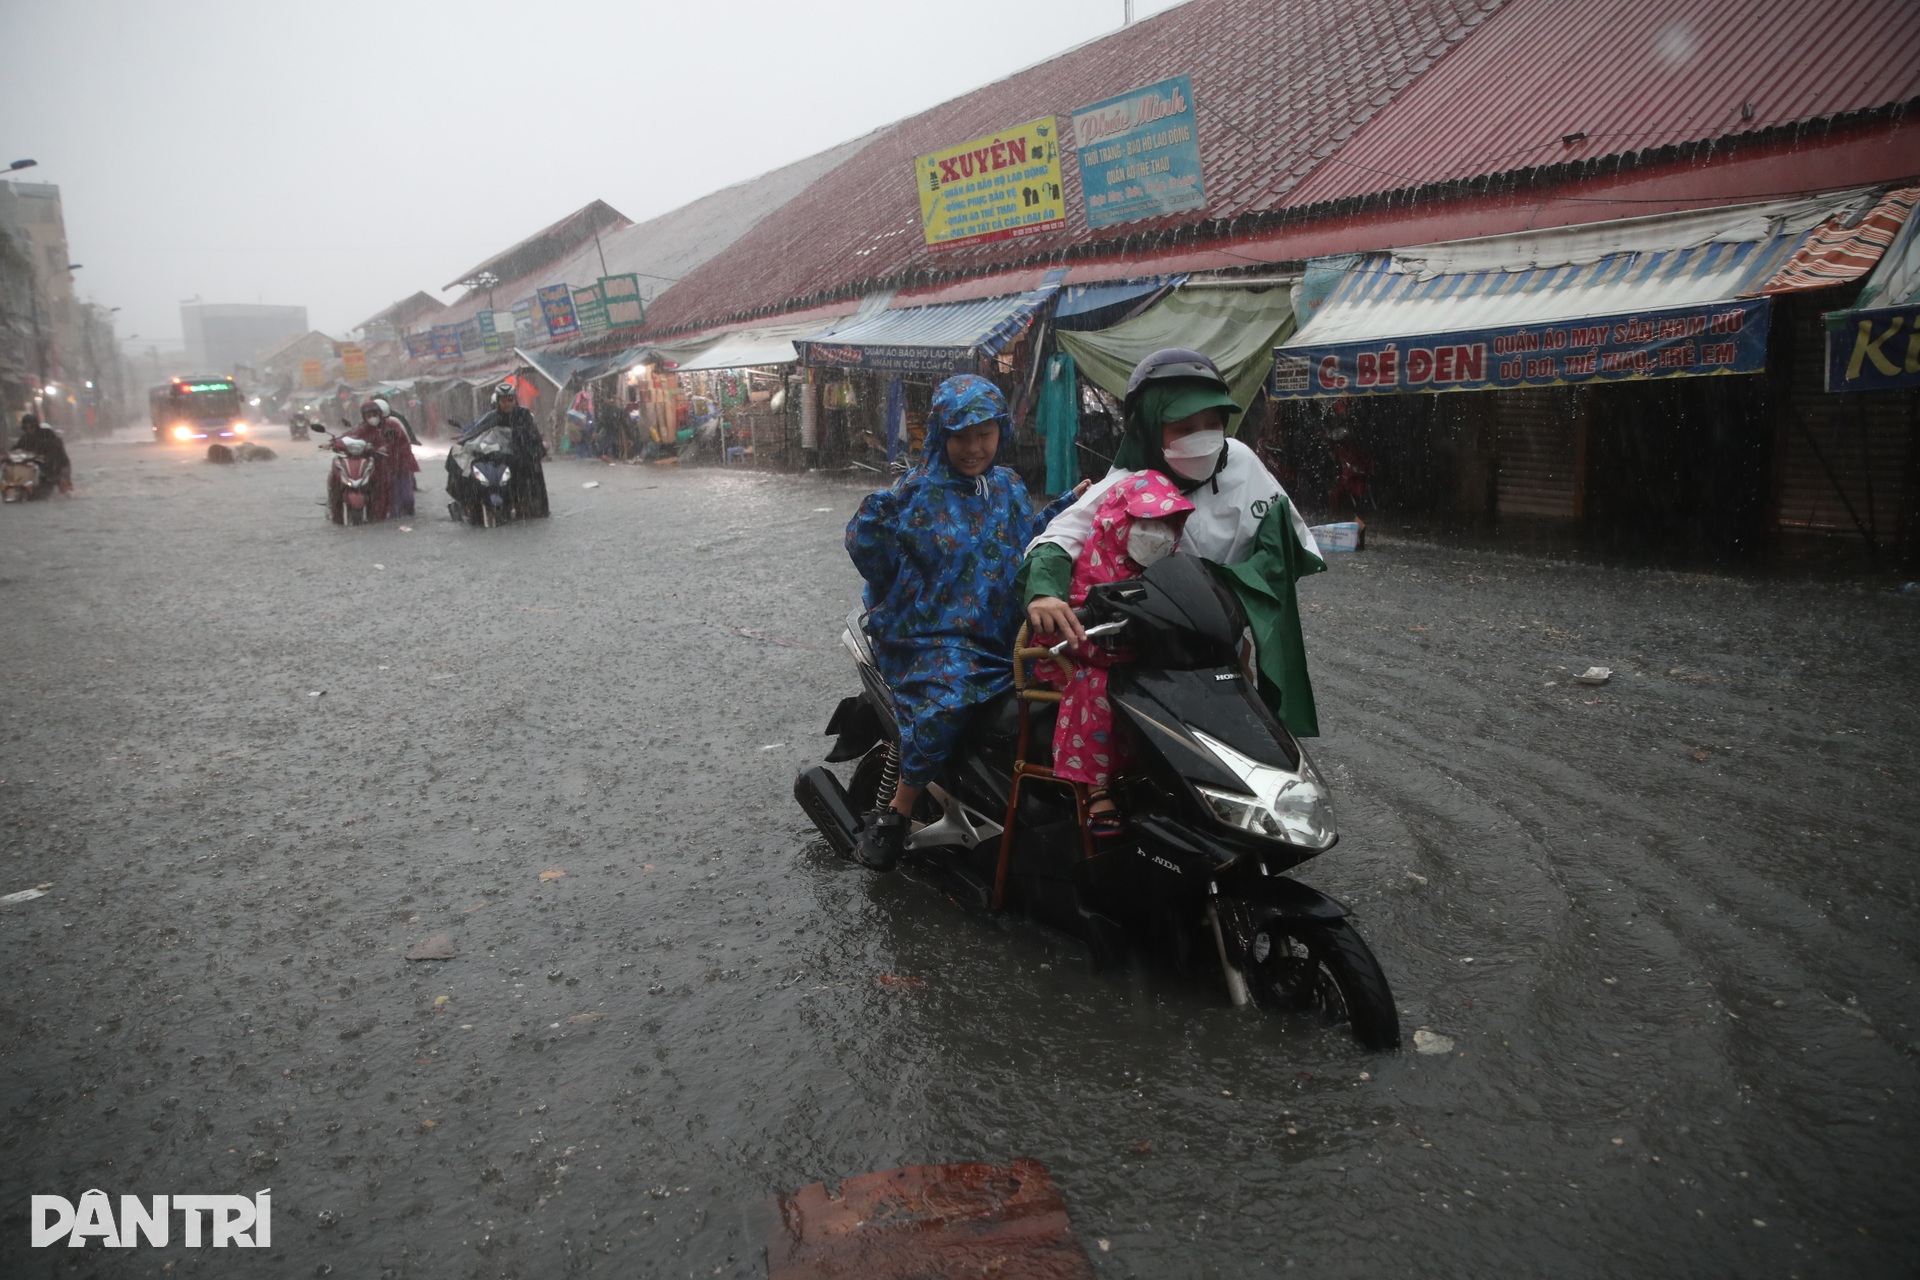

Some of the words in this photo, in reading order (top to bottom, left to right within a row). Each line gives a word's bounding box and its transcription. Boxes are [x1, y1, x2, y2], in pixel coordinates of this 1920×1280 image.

[1134, 87, 1187, 126] Minh
[938, 137, 1026, 184] XUYÊN
[1099, 144, 1122, 162] TRANG
[1154, 132, 1167, 148] LAO
[1007, 171, 1023, 183] LAO
[1151, 157, 1170, 174] THAO
[996, 203, 1017, 215] THAO
[1494, 328, 1539, 356] QUẦN
[1542, 327, 1567, 351] ÁO
[1570, 326, 1609, 348] MAY
[1613, 316, 1655, 344] SẴN
[1658, 316, 1707, 340] NAM
[1710, 308, 1746, 335] NỮ
[1355, 342, 1399, 387] BÉ
[1406, 344, 1487, 385] ĐEN
[1500, 354, 1523, 380] ĐỒ
[1564, 347, 1598, 375] THỂ
[1658, 341, 1696, 367] TRẺ
[1701, 342, 1735, 366] EM
[1137, 846, 1181, 874] HNDA
